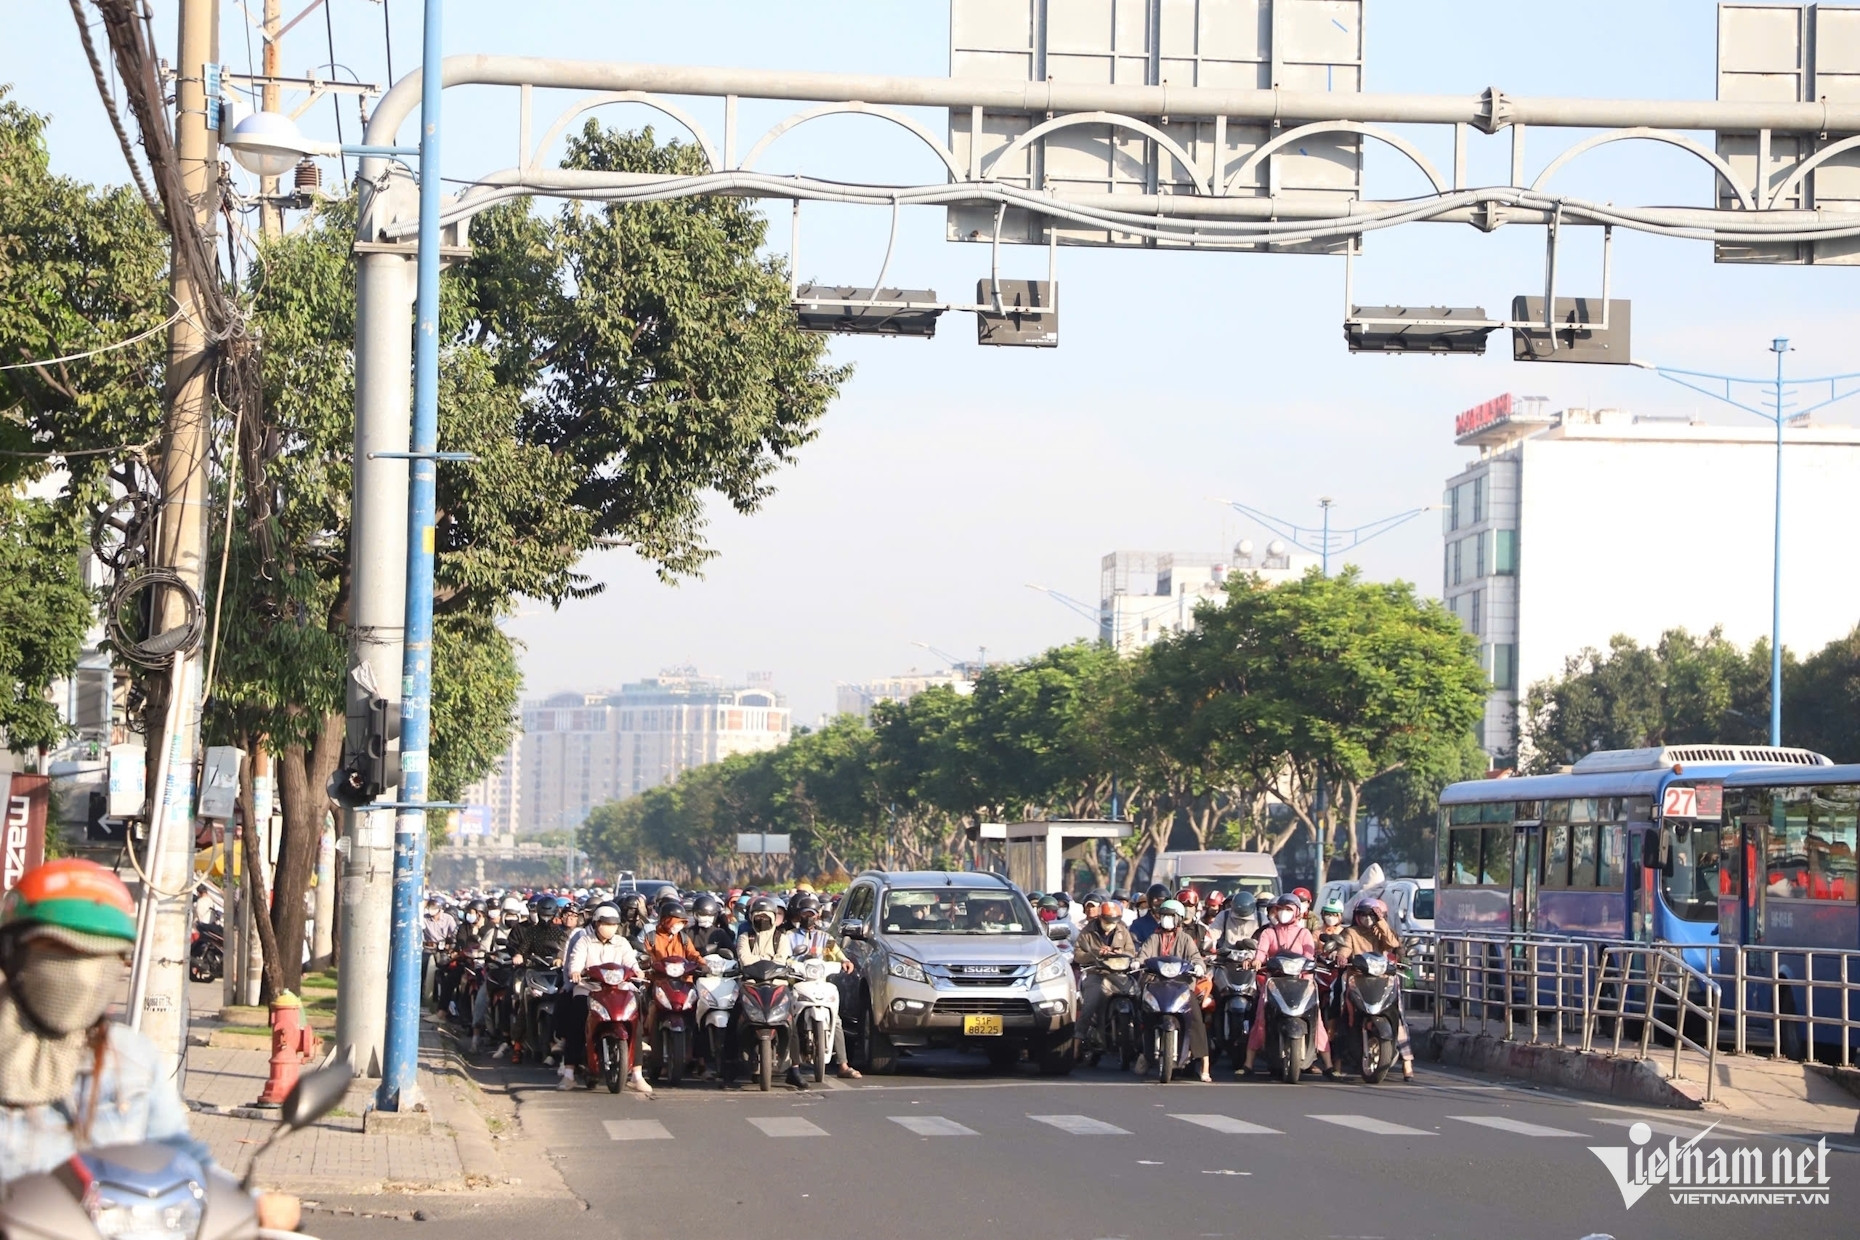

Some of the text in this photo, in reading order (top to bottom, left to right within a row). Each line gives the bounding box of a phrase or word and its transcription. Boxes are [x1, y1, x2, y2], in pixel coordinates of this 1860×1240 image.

[1666, 789, 1695, 815] 27
[975, 1017, 992, 1025] 51F
[968, 1026, 999, 1034] 882.25
